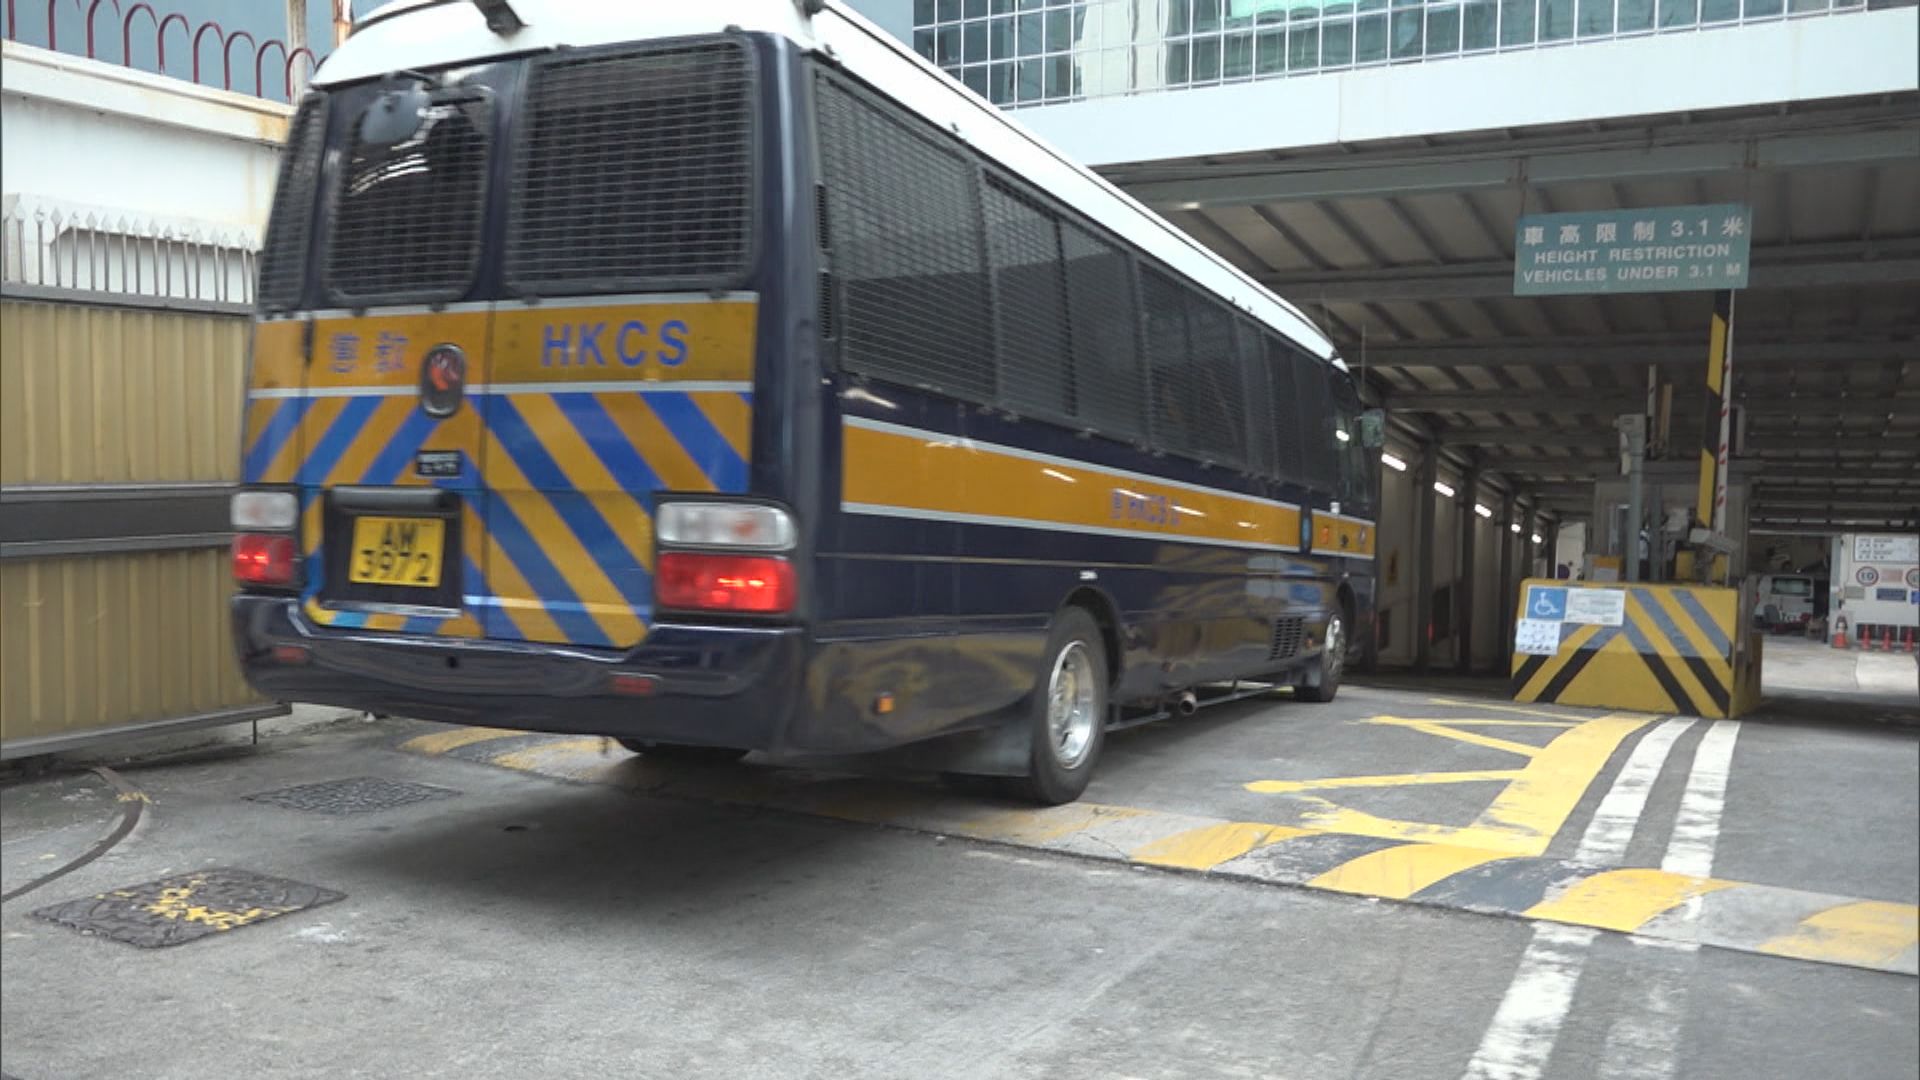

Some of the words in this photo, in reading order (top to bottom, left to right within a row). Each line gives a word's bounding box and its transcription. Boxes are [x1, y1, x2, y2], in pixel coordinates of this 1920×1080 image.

[1534, 249, 1598, 265] HEIGHT
[1609, 243, 1730, 262] RESTRICTION
[1522, 267, 1607, 284] VEHICLES
[1617, 265, 1679, 281] UNDER
[1689, 264, 1714, 279] 3.1
[1726, 263, 1741, 277] M
[541, 319, 689, 367] HKCS
[359, 549, 432, 582] 3972
